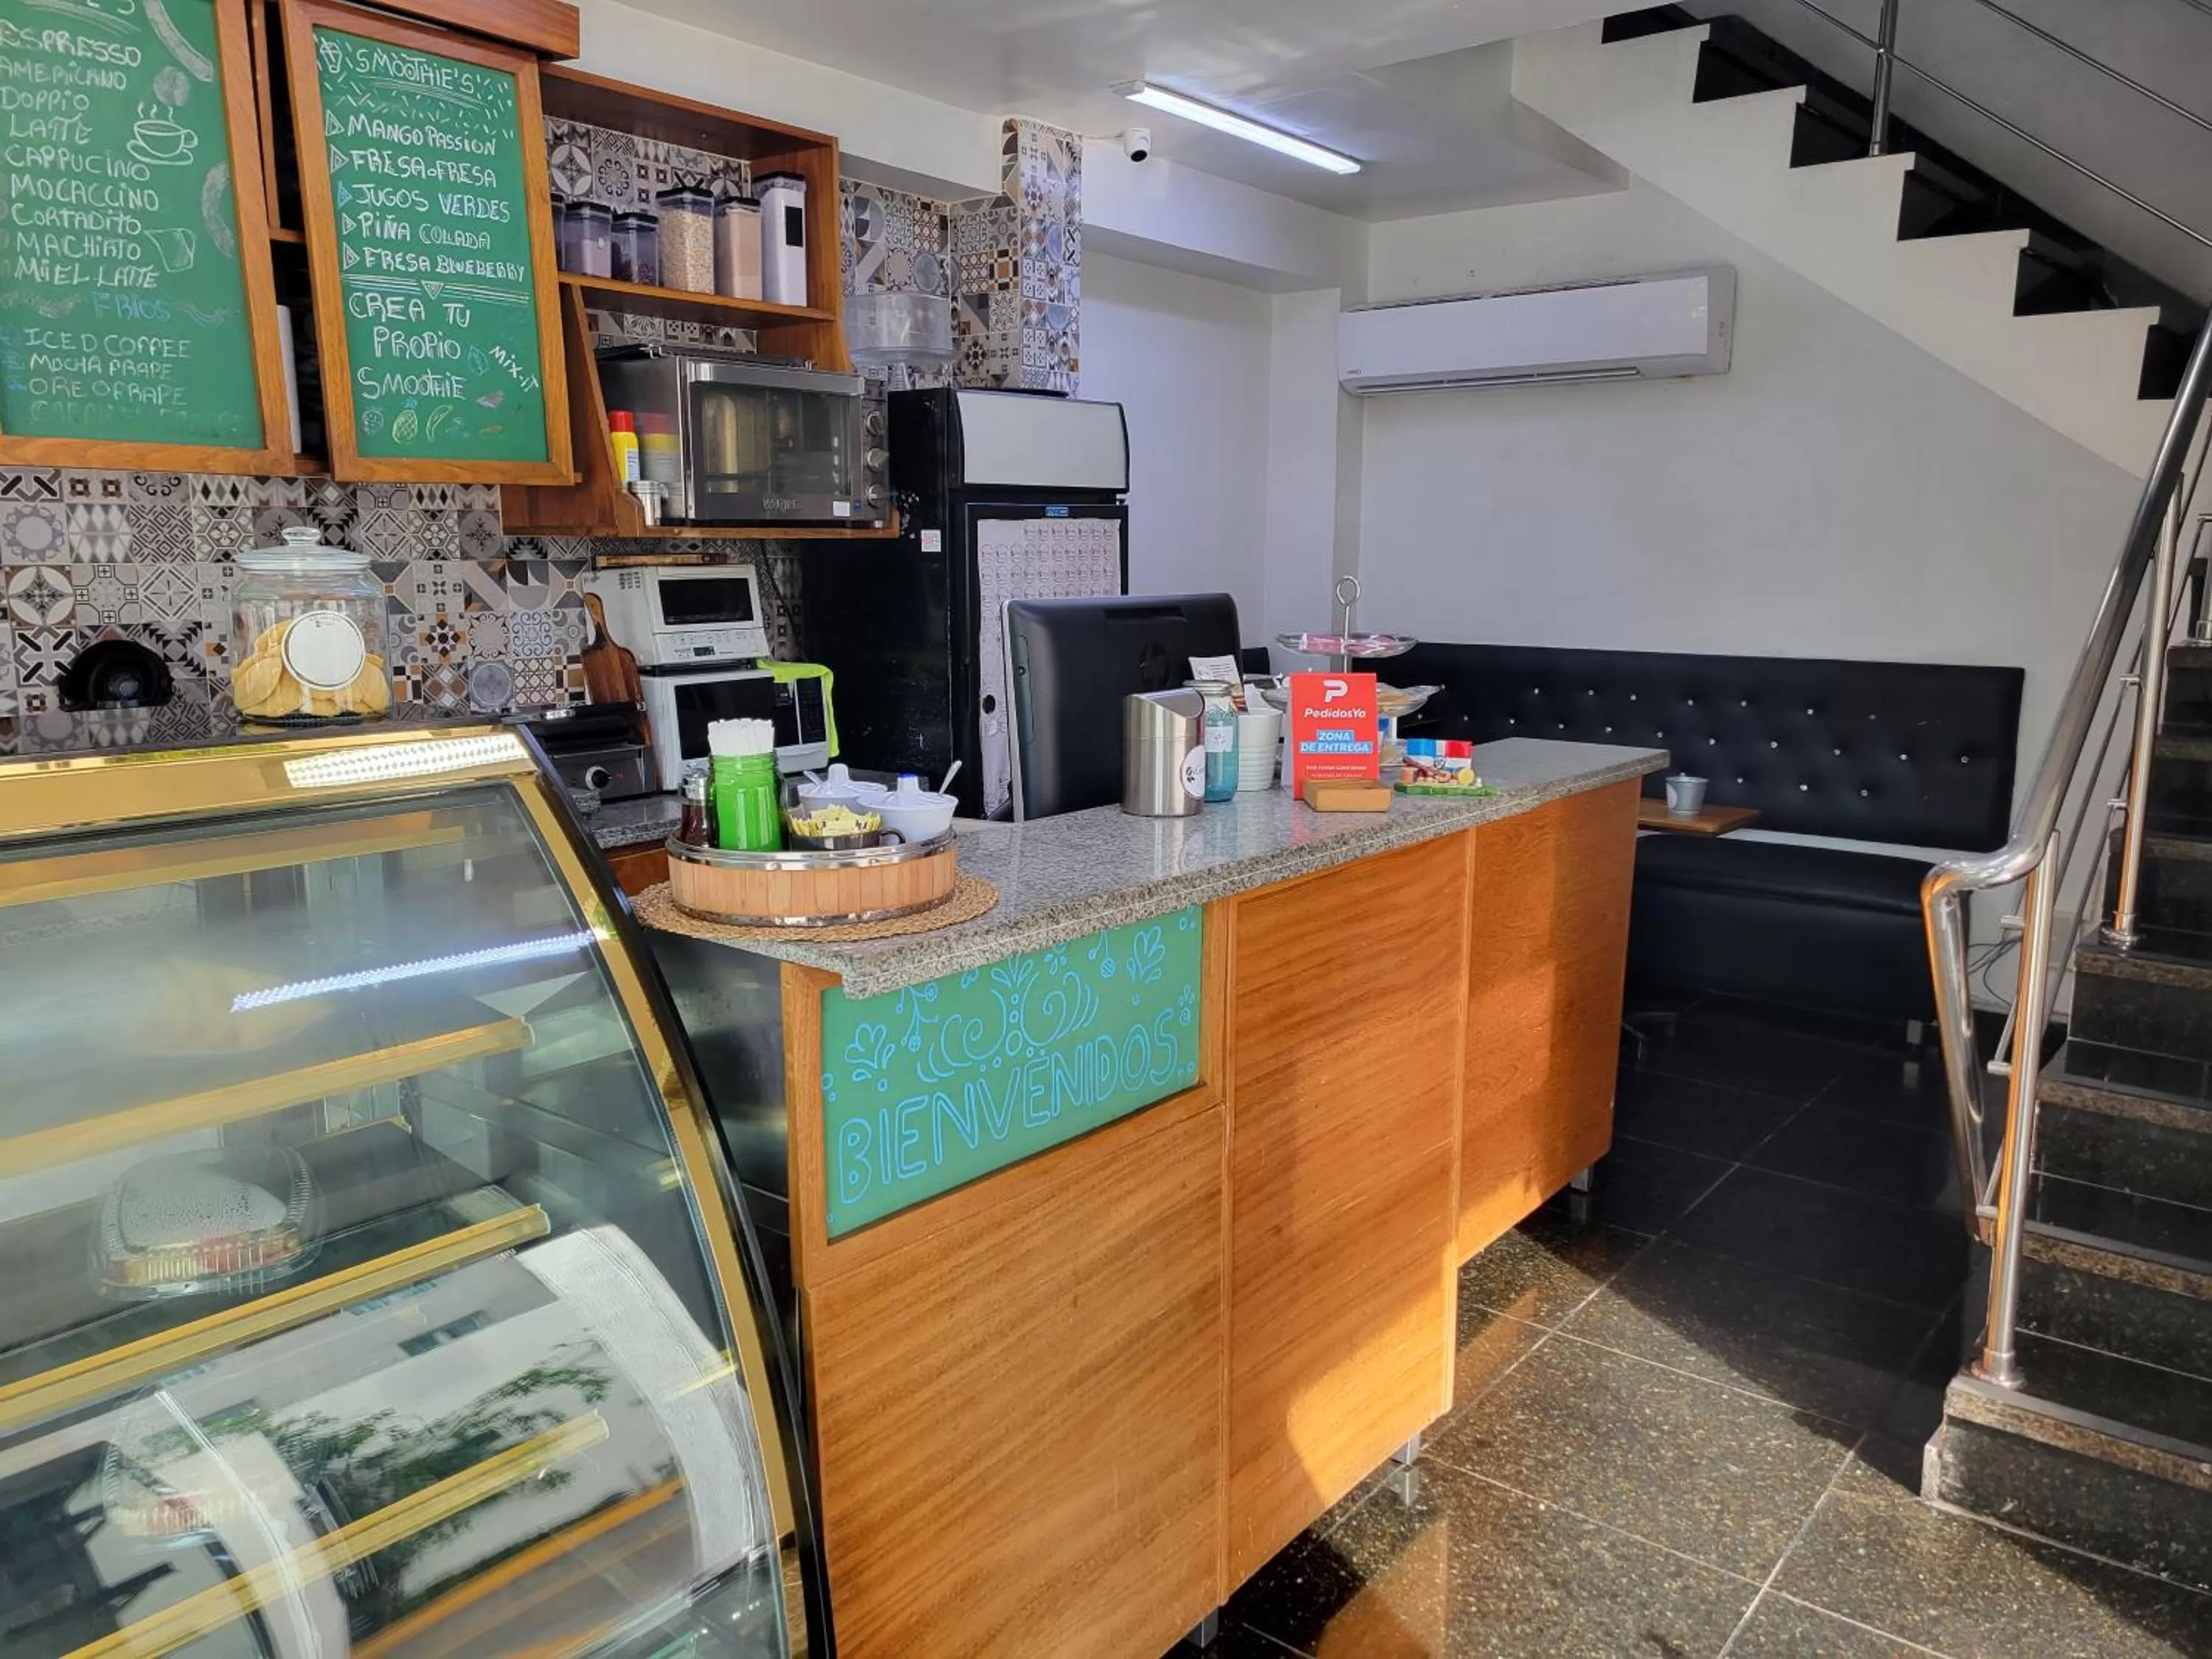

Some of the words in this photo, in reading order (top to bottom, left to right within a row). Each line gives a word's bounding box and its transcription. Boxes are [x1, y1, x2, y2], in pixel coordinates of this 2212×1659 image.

[9, 112, 94, 144] LATTE
[347, 113, 424, 147] MANGO
[425, 125, 496, 156] PASSION
[5, 144, 150, 181] CAPPUCINO
[352, 184, 430, 212] JUGOS
[438, 192, 511, 224] VERDES
[361, 246, 431, 273] FRESA
[348, 292, 426, 323] CREA
[442, 303, 471, 328] TU
[24, 327, 99, 353] ICED
[103, 334, 192, 358] COFFEE
[373, 325, 462, 361] PROPIO
[29, 352, 102, 375] MOCHA
[108, 359, 174, 380] FRAPE
[356, 367, 467, 400] SMOOTHIE
[1303, 707, 1368, 719] PedidosYa
[1300, 742, 1316, 752] DE
[1318, 742, 1370, 752] ENTREGA
[1319, 732, 1351, 741] ZONA
[838, 1008, 1179, 1205] BIENVENIDOS
